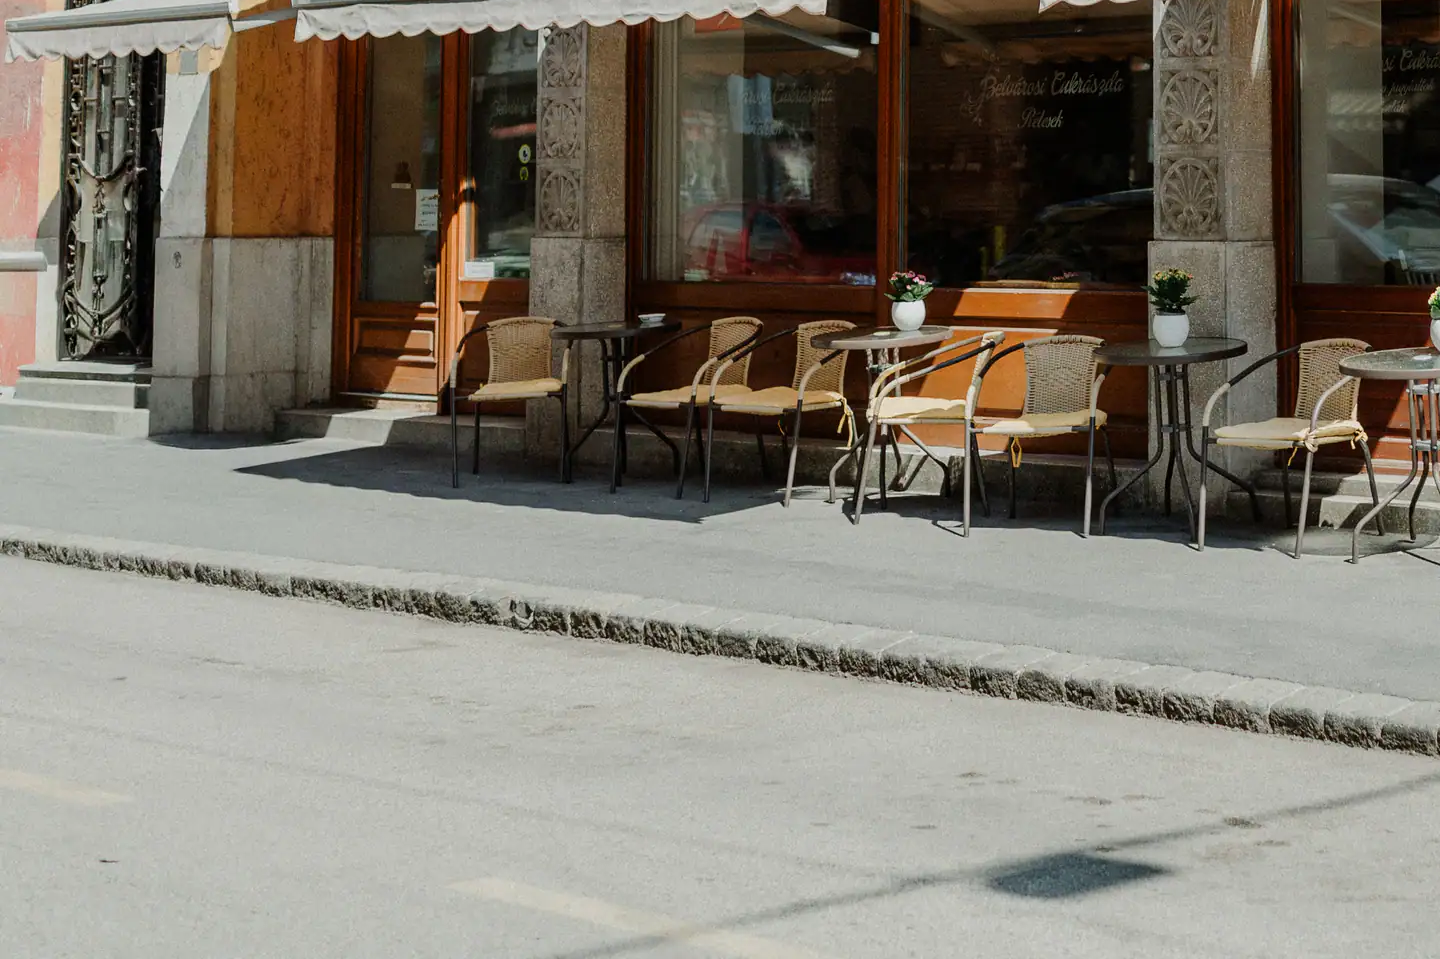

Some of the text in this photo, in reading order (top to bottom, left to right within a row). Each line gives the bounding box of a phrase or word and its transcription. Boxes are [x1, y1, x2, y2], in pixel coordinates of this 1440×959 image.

[983, 69, 1125, 100] Belvárosi Cukrászda
[1016, 107, 1065, 129] Rétesek
